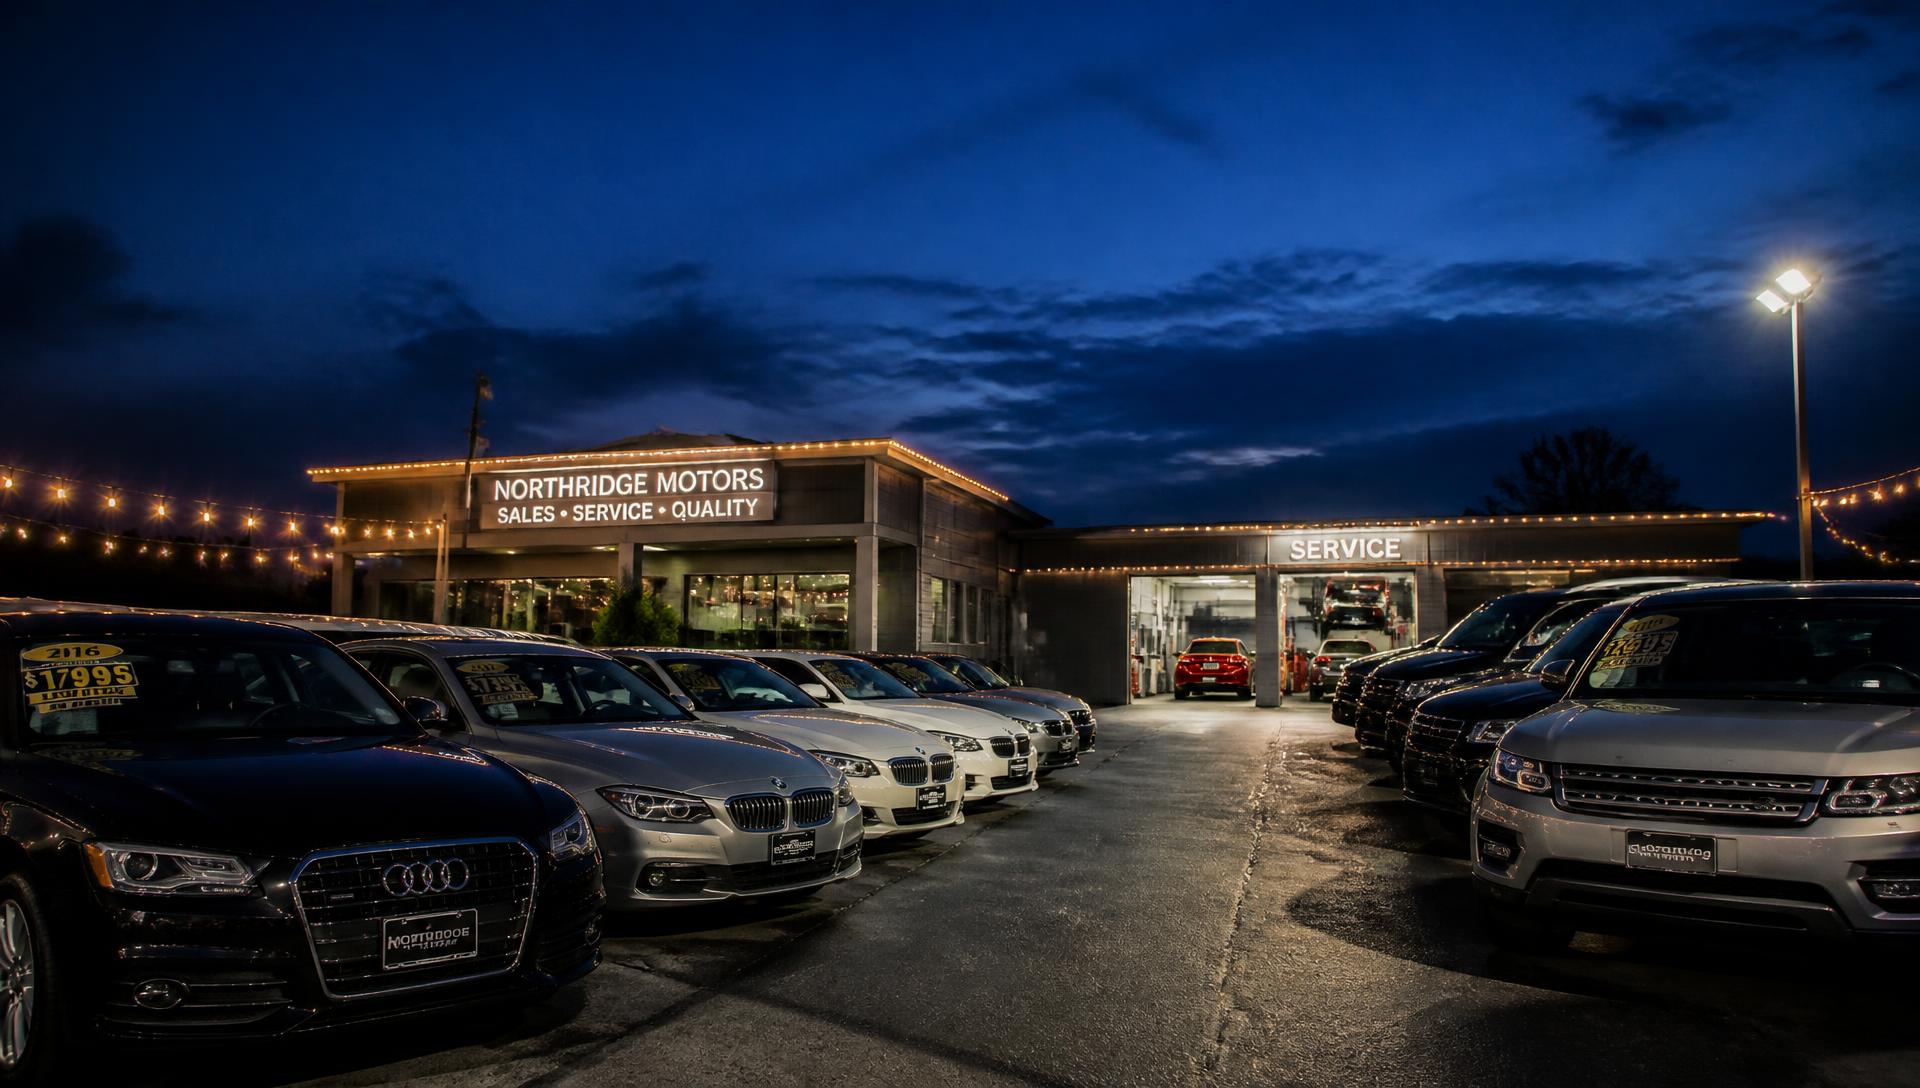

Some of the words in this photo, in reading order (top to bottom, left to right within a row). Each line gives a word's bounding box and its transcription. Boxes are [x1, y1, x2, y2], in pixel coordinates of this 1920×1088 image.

[494, 473, 648, 501] NORTHRIDGE
[656, 468, 764, 493] MOTORS
[497, 505, 555, 524] SALES
[572, 502, 653, 521] SERVICE
[671, 498, 758, 521] QUALITY
[1290, 538, 1401, 560] SERVICE
[24, 665, 133, 690] $17995
